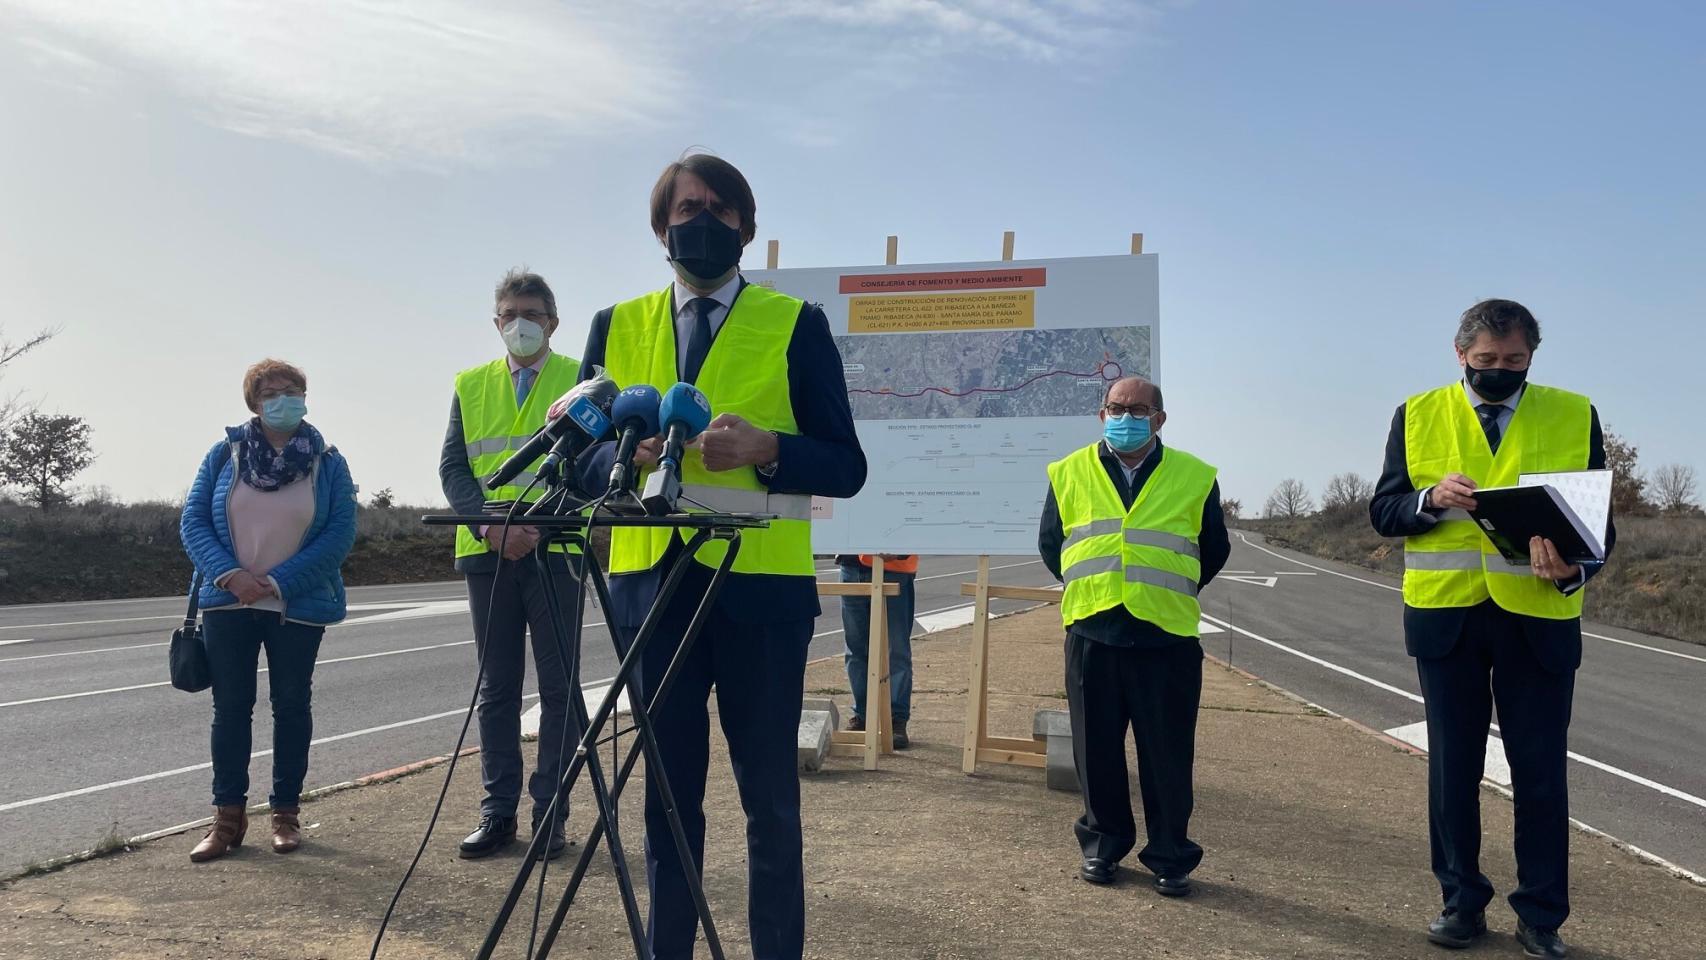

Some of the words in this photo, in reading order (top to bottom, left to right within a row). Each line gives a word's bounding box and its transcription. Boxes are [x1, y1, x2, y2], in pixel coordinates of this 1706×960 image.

[861, 280, 905, 288] CONSEJERÍA
[961, 277, 984, 285] MEDIO
[887, 297, 936, 305] CONSTRUCCIÓN
[874, 305, 911, 313] CARRETERA
[944, 303, 975, 311] RIBASECA
[940, 311, 961, 319] SANTA
[986, 317, 996, 325] DE
[620, 388, 646, 397] tve
